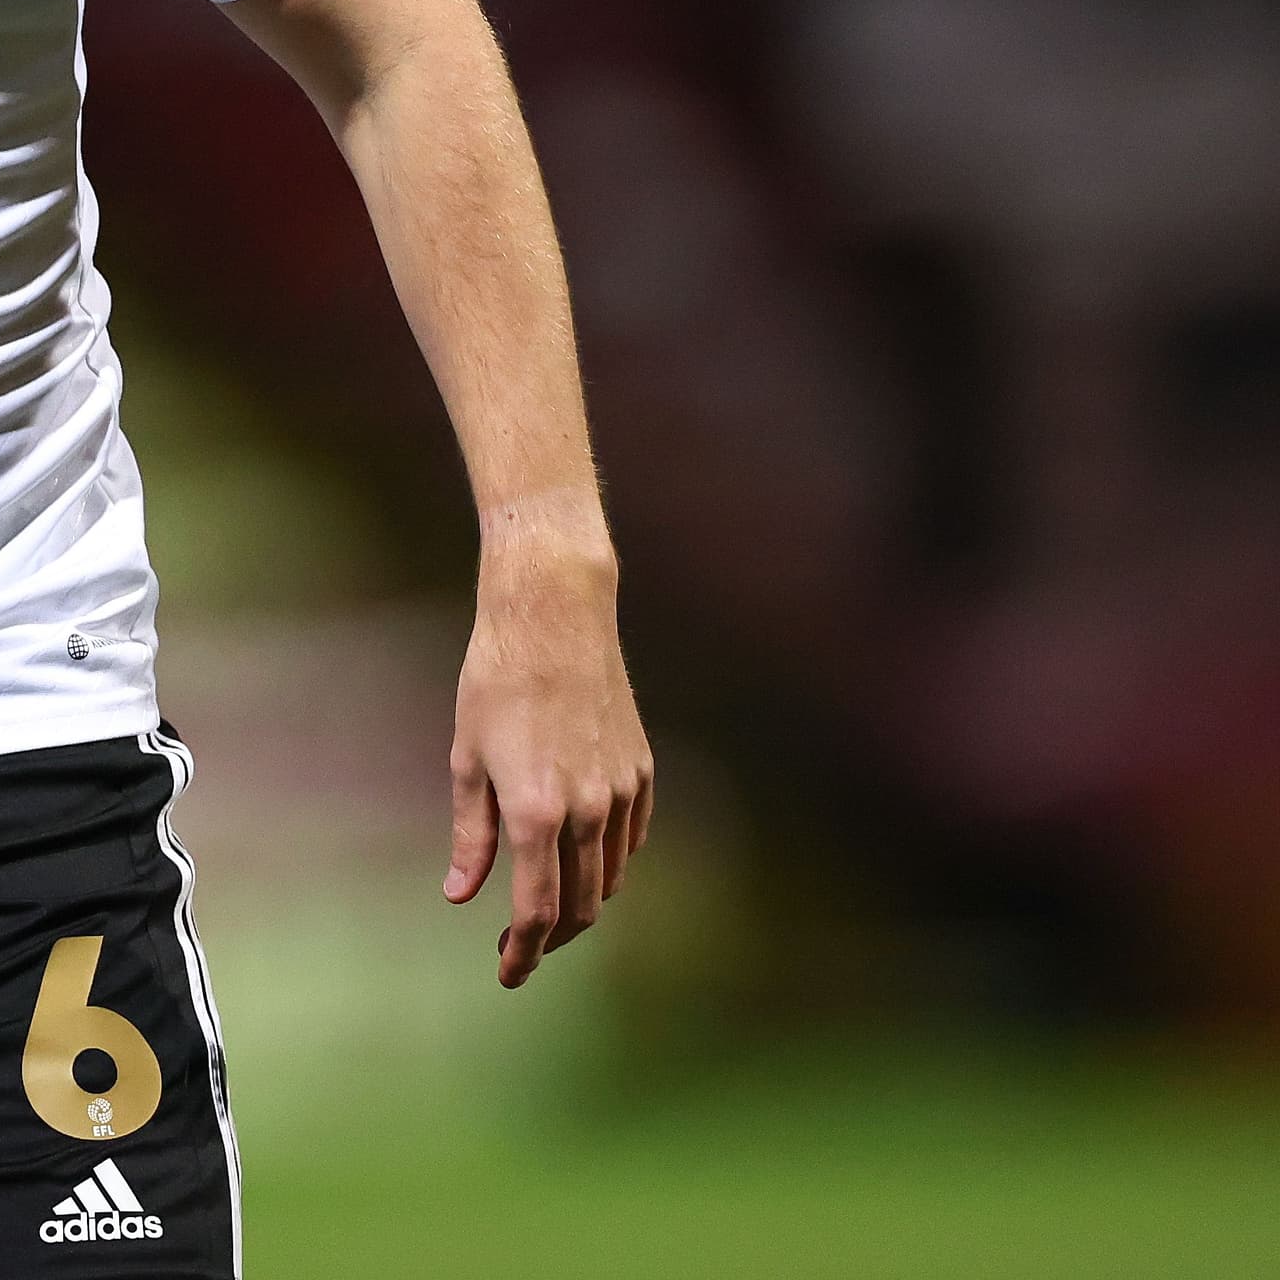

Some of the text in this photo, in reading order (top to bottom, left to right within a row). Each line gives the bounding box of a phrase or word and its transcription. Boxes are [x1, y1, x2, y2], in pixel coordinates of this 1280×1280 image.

[21, 935, 163, 1141] 6
[92, 1124, 116, 1137] EFL
[39, 1210, 164, 1244] adidas
